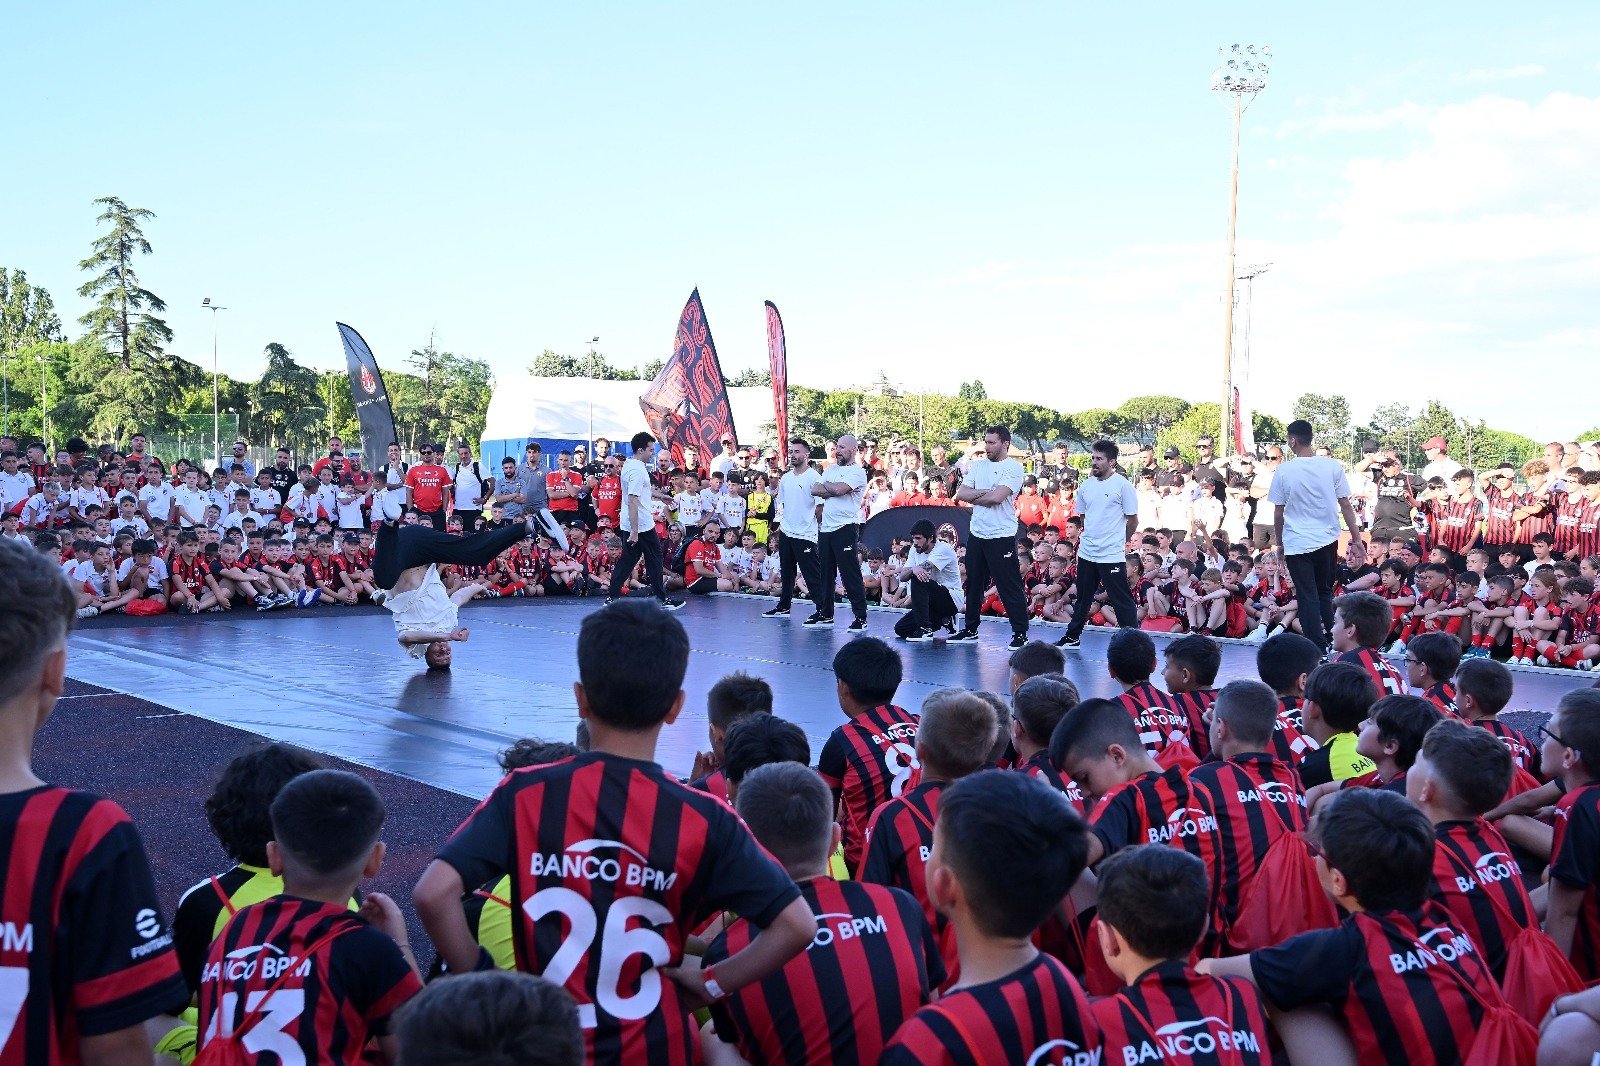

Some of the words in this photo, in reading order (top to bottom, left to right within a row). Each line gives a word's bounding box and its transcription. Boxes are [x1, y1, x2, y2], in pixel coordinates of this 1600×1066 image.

[1134, 714, 1168, 728] ANCO
[1168, 715, 1188, 727] BPM
[1351, 757, 1374, 773] BAN
[530, 852, 622, 882] BANCO
[625, 862, 678, 891] BPM
[837, 914, 888, 941] BPM
[260, 956, 312, 979] BPM
[522, 886, 675, 1029] 26
[1388, 941, 1457, 975] BANO
[1121, 1031, 1217, 1066] BANCO
[1217, 1029, 1261, 1053] BPM
